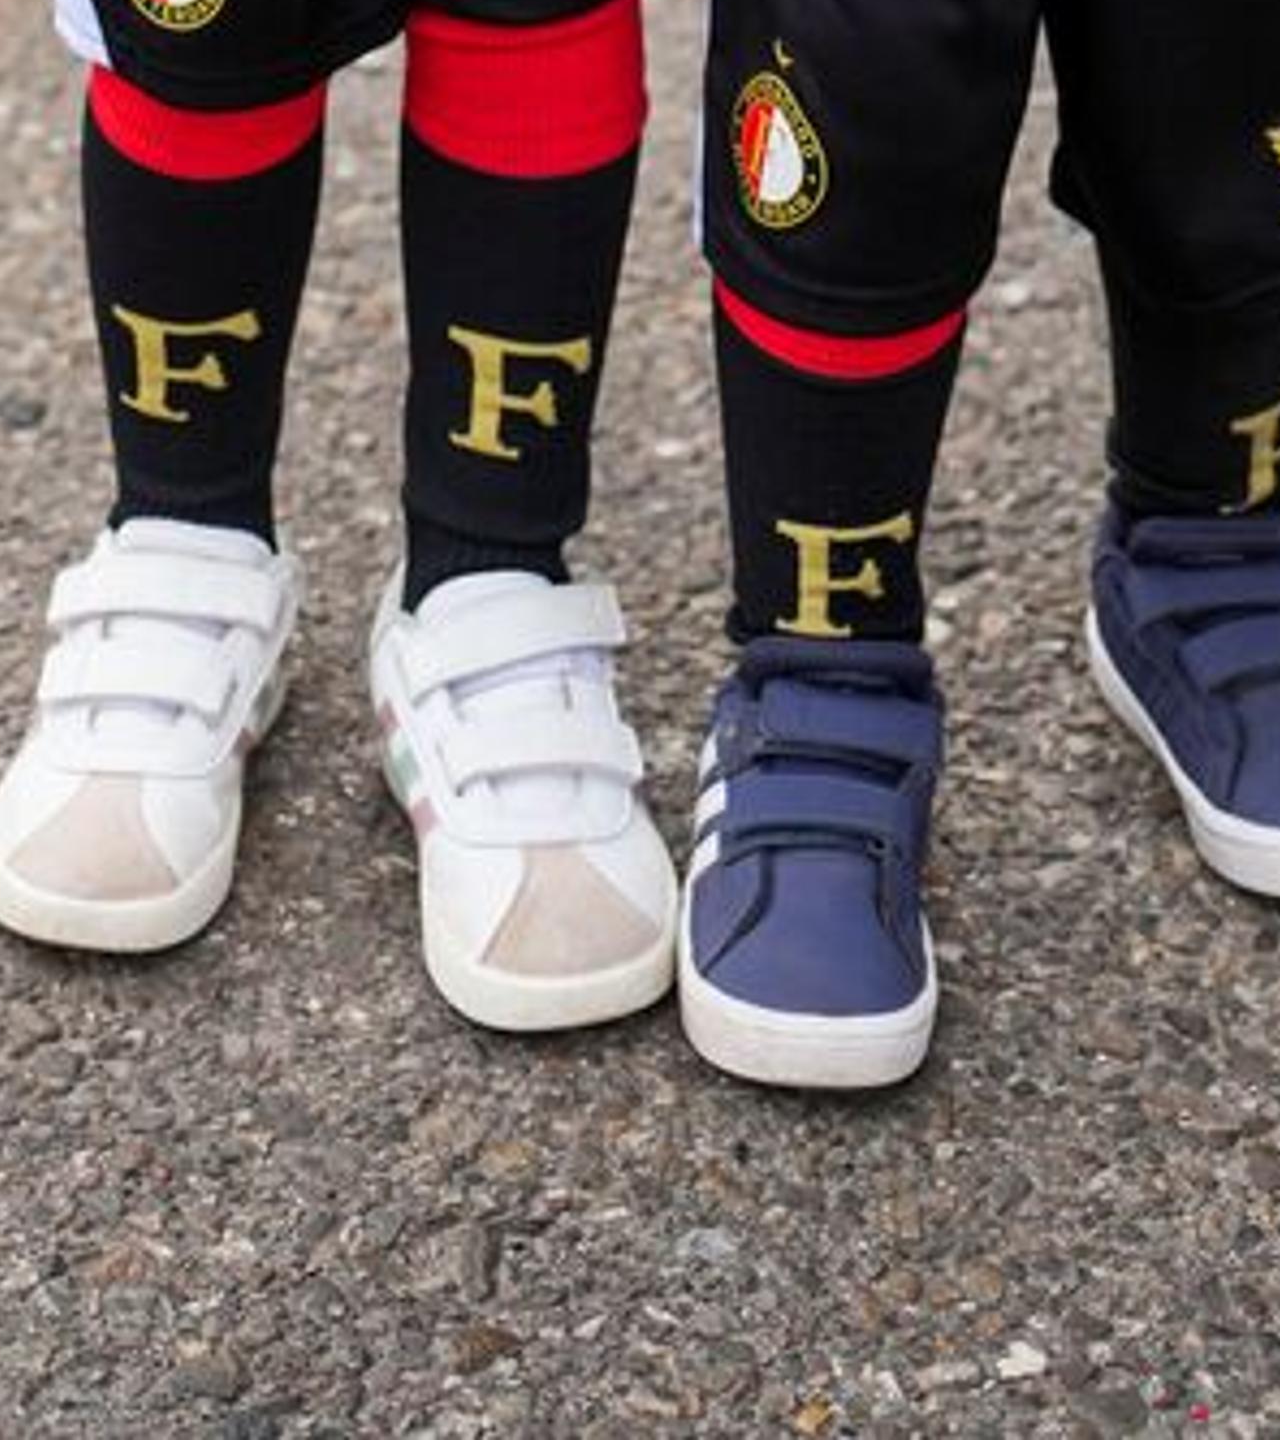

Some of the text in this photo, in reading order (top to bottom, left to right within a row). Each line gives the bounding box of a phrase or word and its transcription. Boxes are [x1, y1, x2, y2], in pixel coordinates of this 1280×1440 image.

[114, 307, 261, 422] F
[448, 326, 592, 460] F
[776, 512, 913, 638] F
